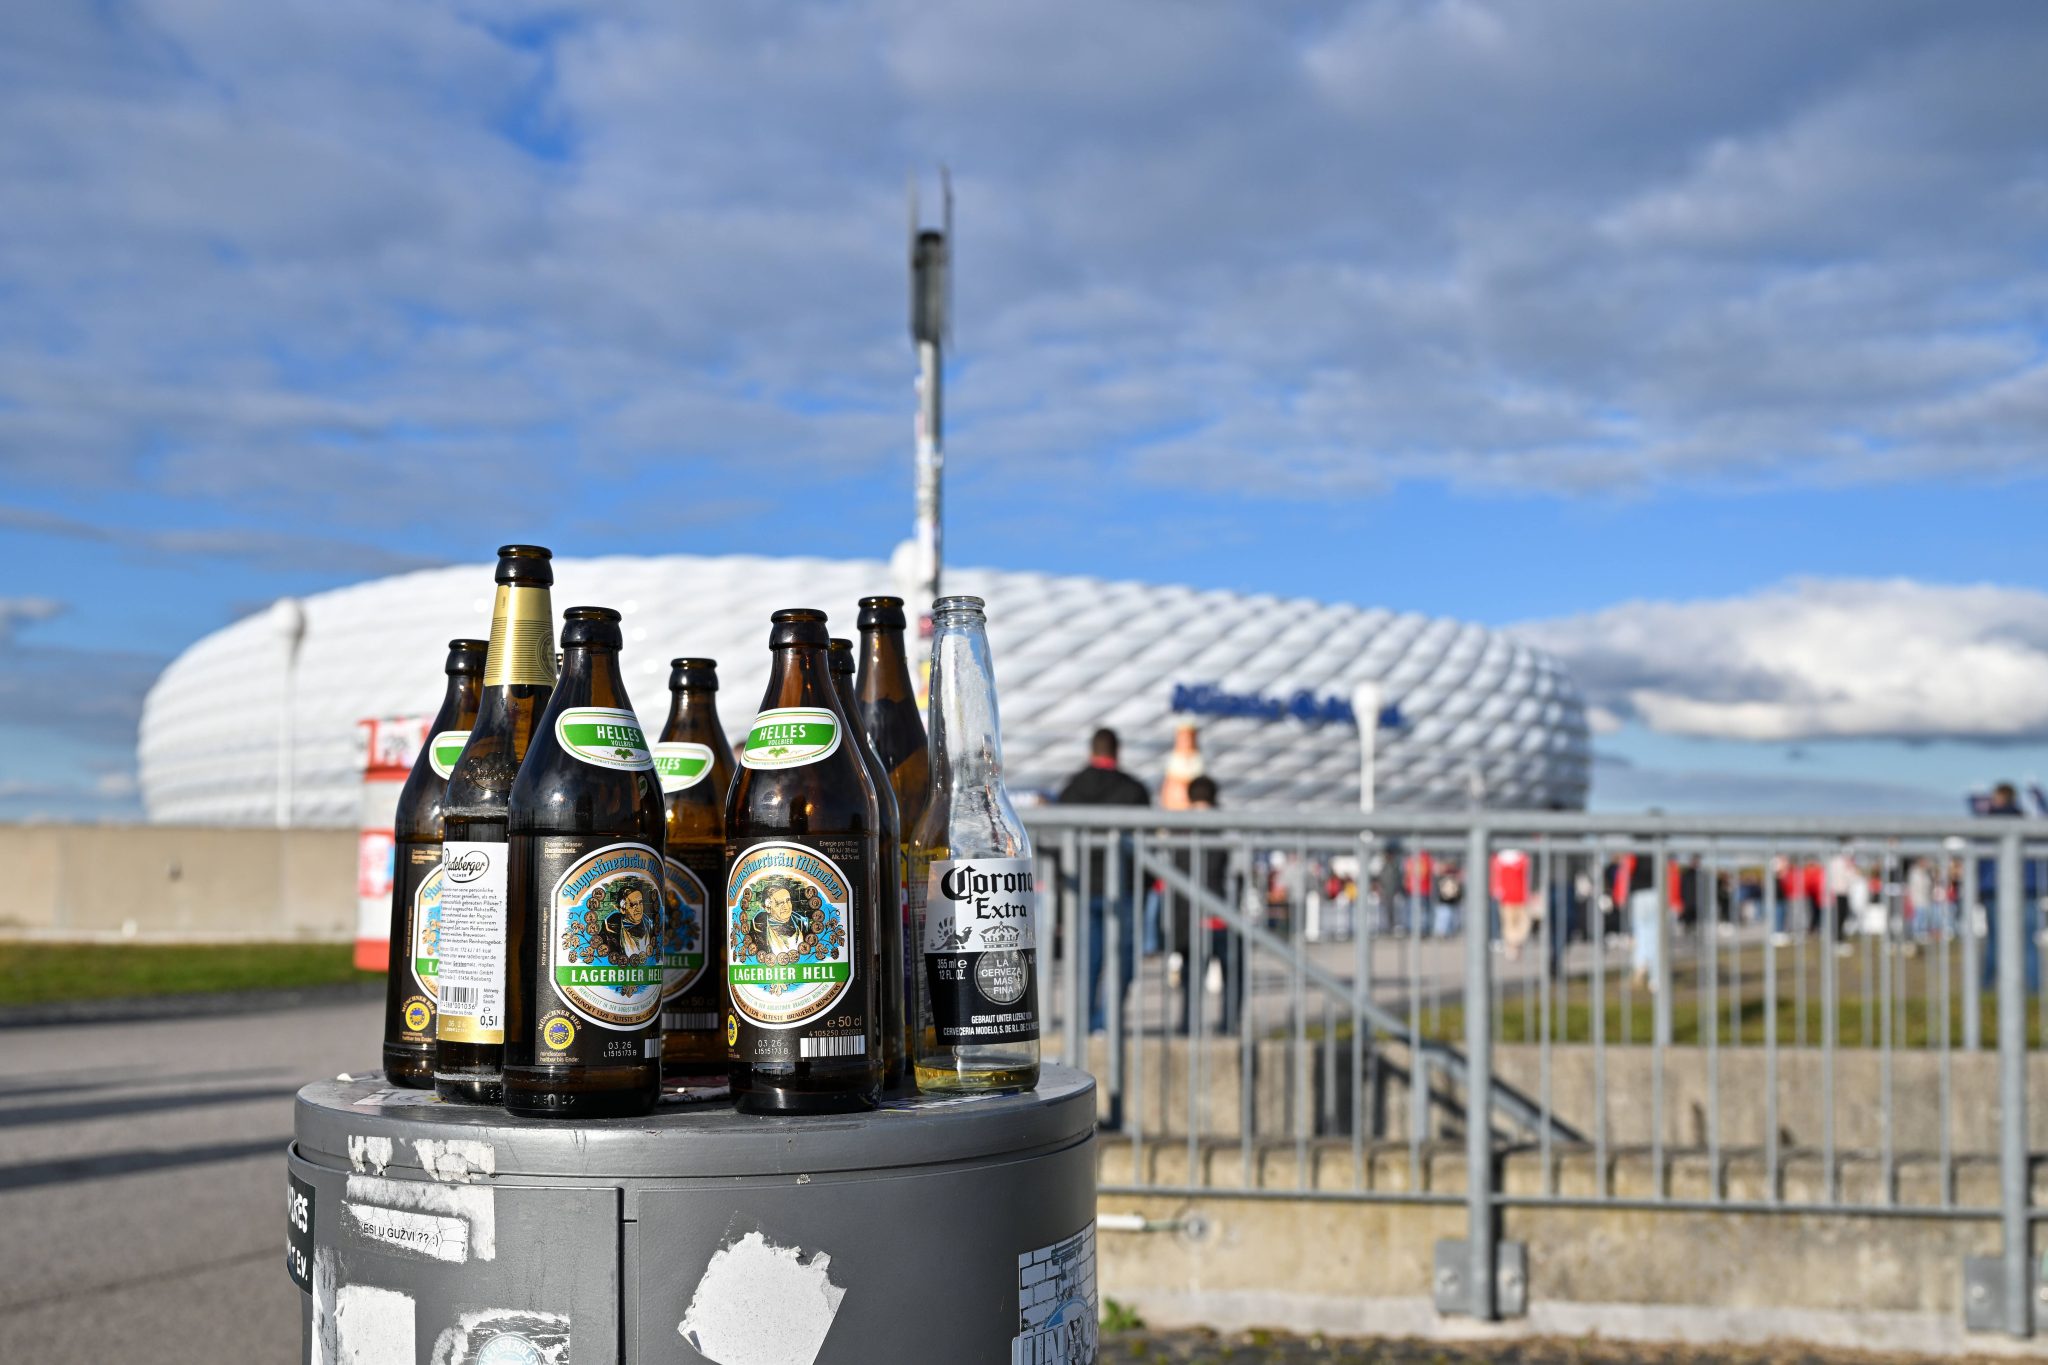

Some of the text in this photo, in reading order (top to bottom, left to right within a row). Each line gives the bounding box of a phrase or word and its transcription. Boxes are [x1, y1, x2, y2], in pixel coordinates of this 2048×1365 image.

[596, 726, 640, 742] HELLES
[759, 725, 806, 740] HELLES
[652, 758, 680, 770] ELLES
[562, 853, 646, 900] Augustinerbräu
[729, 853, 794, 900] Augustinerbräu
[795, 855, 843, 900] München
[941, 865, 1034, 904] Corona
[975, 897, 1027, 919] Extra
[664, 956, 690, 966] HELL
[937, 959, 948, 968] 355
[949, 959, 957, 968] ml
[996, 959, 1009, 967] LA
[571, 969, 644, 983] LAGERBIER
[734, 966, 835, 980] LAGERBIER HELL
[939, 969, 965, 980] 12 FL. OZ.
[981, 967, 1022, 977] CERVEZA
[994, 977, 1013, 985] MAS
[993, 986, 1014, 994] FINA
[565, 987, 595, 1014] GEGRÜNDET
[786, 1006, 814, 1020] BRAUEREI
[815, 984, 841, 1009] MÜNCHENS
[792, 996, 811, 1008] BRAUEREI
[538, 1009, 582, 1031] MÜNCHNER BIER
[838, 1016, 851, 1027] 50
[854, 1016, 862, 1026] cl
[971, 1014, 996, 1024] GEBRAUT
[996, 1014, 1012, 1022] UNTER
[1012, 1012, 1026, 1021] LIZENZ
[943, 1027, 974, 1036] CERVECERIA
[975, 1026, 999, 1035] MODELO,
[1005, 1025, 1011, 1033] DE
[1020, 1023, 1026, 1032] DE
[362, 1223, 376, 1234] ESI
[379, 1226, 384, 1237] U
[388, 1227, 415, 1242] GUŽVI
[418, 1232, 429, 1243] ??
